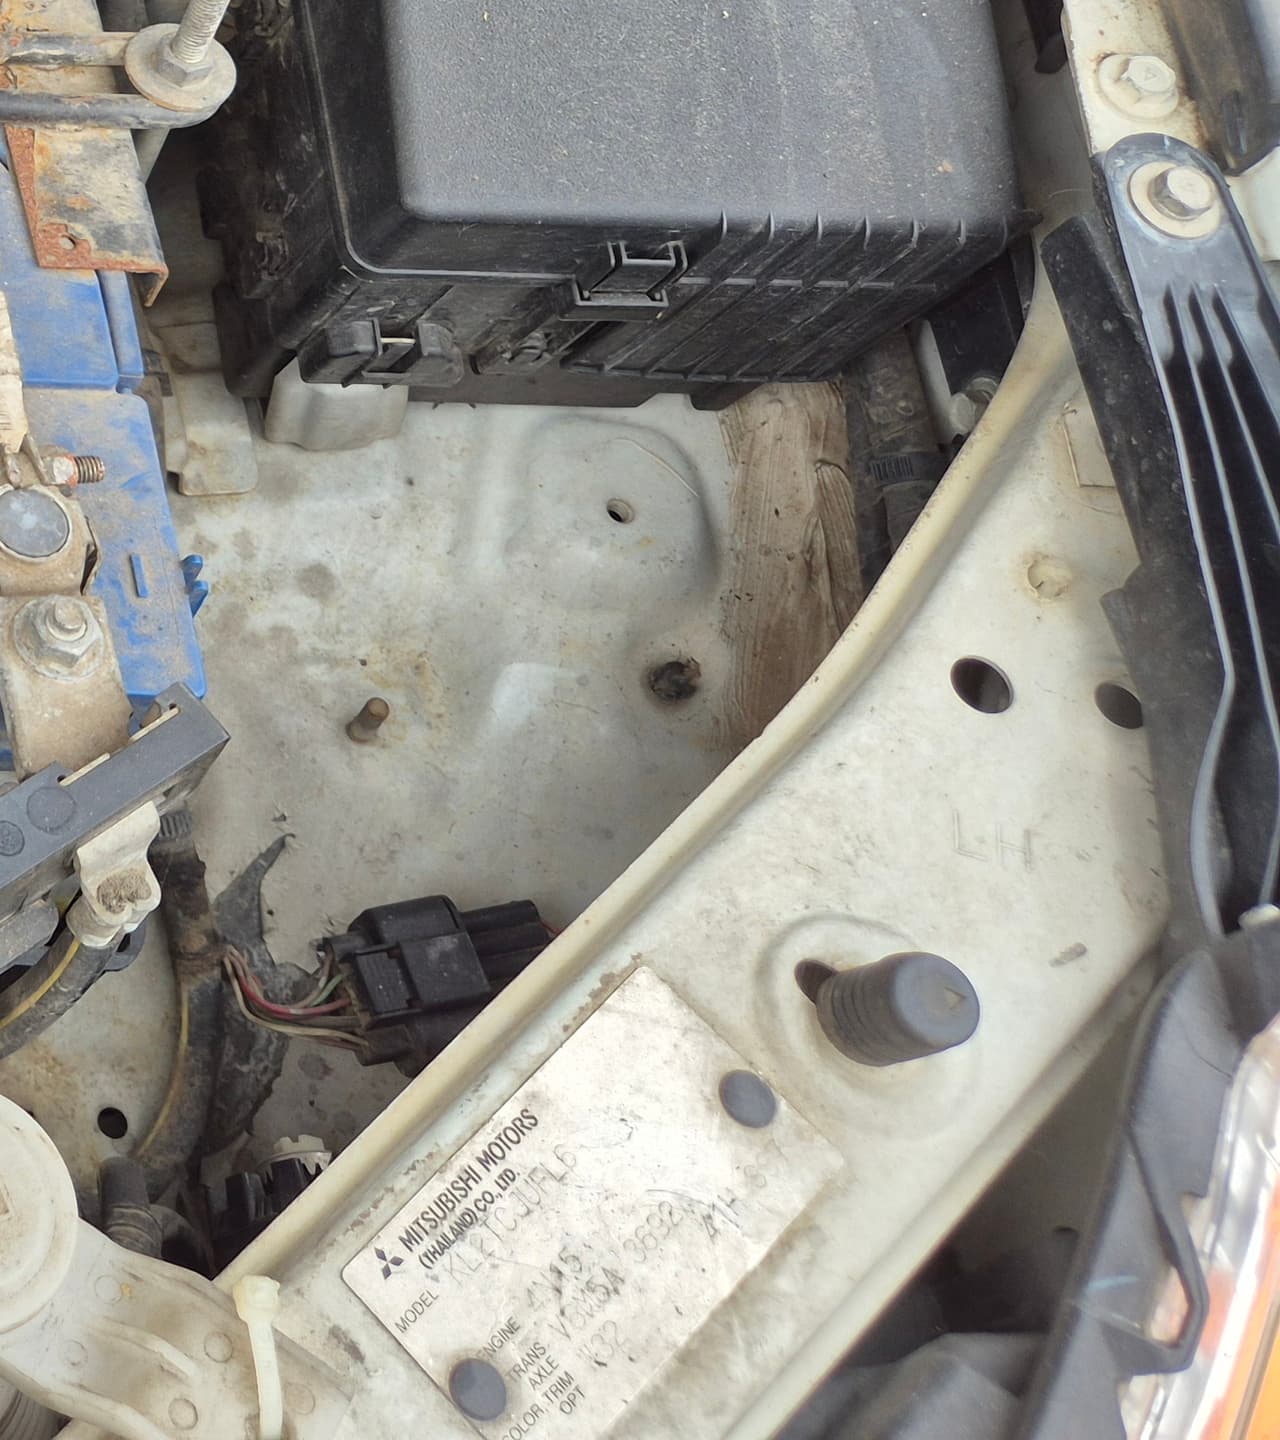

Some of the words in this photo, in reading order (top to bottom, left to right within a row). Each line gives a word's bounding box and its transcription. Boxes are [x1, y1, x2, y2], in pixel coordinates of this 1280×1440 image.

[952, 808, 1033, 873] LH
[398, 1164, 483, 1253] MITSUBISHI
[476, 1108, 539, 1173] MOTORS
[418, 1207, 479, 1270] (THAILAND)
[494, 1167, 521, 1192] LTD.
[395, 1289, 440, 1334] MODEL
[475, 1316, 521, 1360] ENGINE
[506, 1341, 547, 1384] TRANS
[528, 1355, 561, 1392] AXLE
[542, 1370, 575, 1406] TRIM
[559, 1384, 586, 1416] OPT
